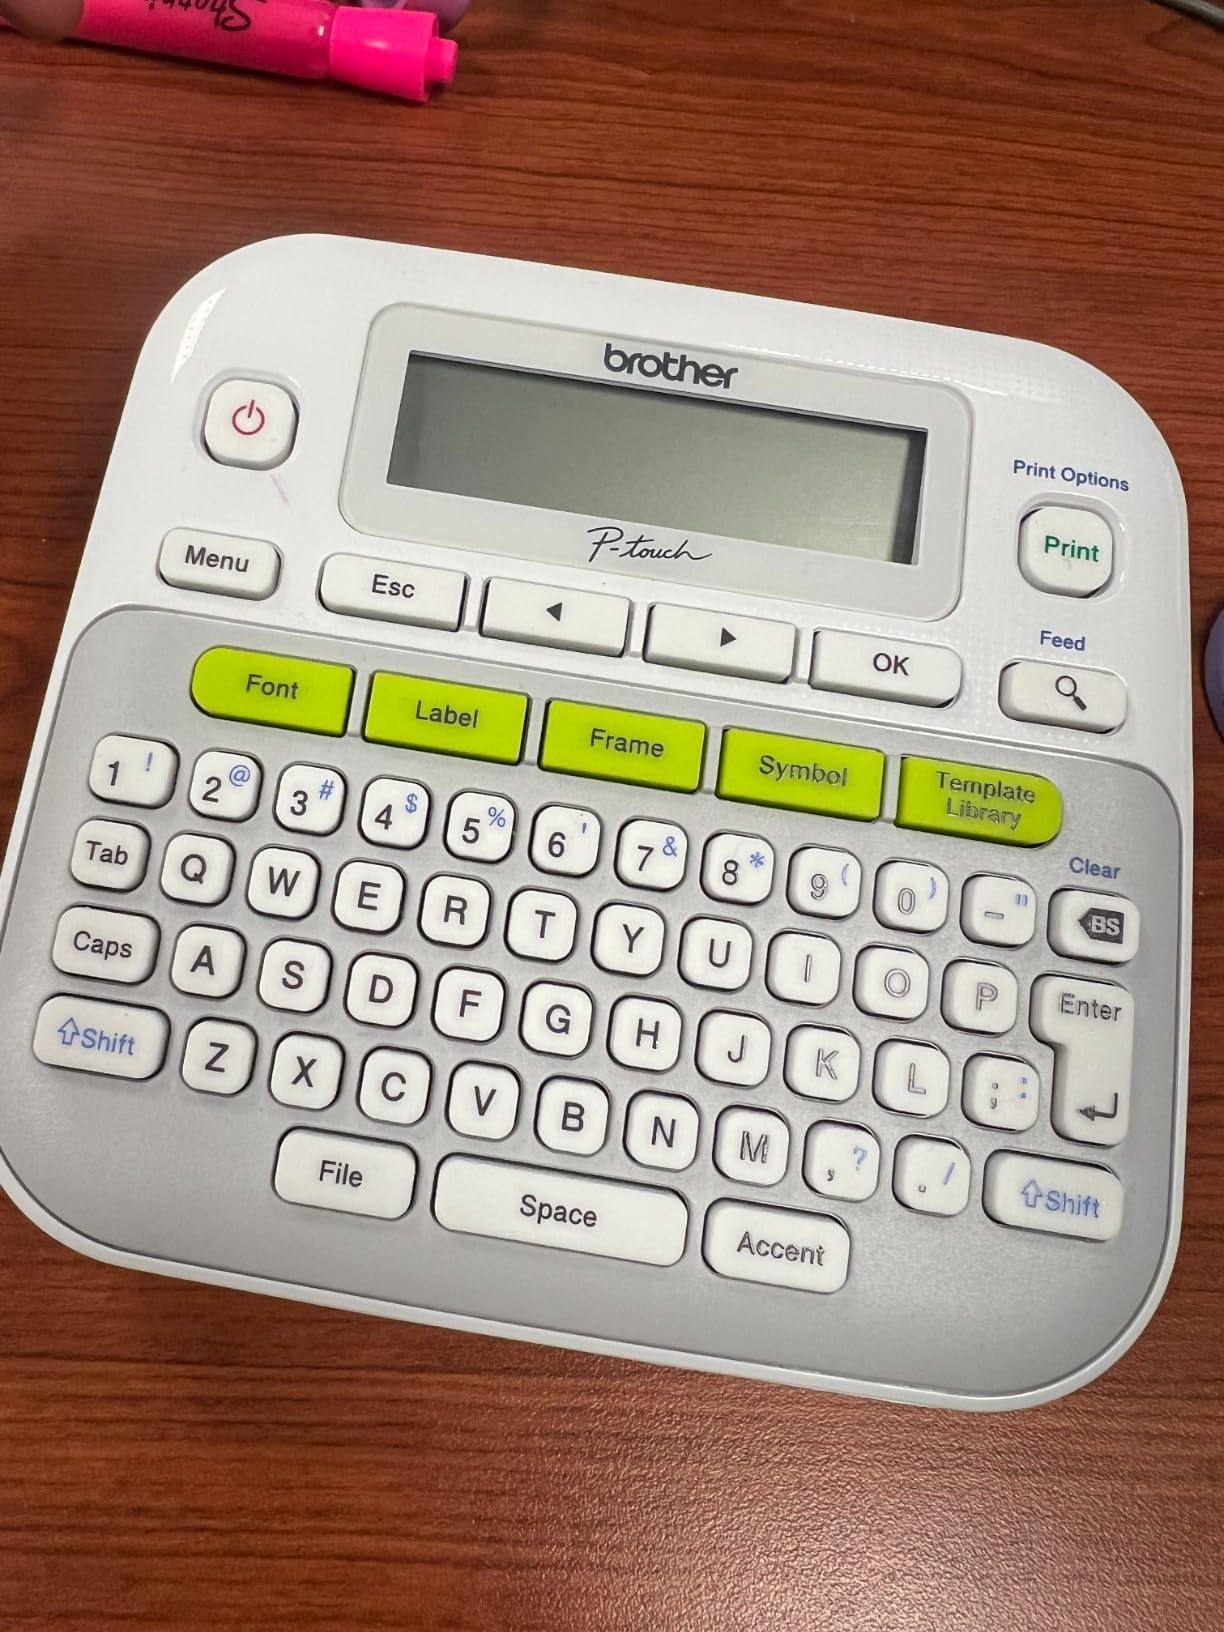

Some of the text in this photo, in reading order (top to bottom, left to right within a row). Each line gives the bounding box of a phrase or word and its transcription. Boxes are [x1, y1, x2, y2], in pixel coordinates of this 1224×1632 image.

[603, 343, 738, 389] brother
[1013, 459, 1130, 492] Print Options
[184, 545, 249, 573] Menu
[587, 526, 713, 562] P-touch
[1044, 535, 1100, 563] Print
[371, 574, 416, 599] Esc
[1040, 630, 1086, 652] Feed
[873, 652, 910, 676] OK
[245, 673, 299, 700] Font
[415, 700, 479, 728] Label
[590, 728, 665, 758] Frame
[108, 752, 153, 786] 1 !
[202, 765, 251, 802] 2 @
[759, 754, 848, 786] Symbol
[290, 779, 335, 816] 3 #
[936, 771, 1036, 804] Template
[374, 792, 418, 830] 4 $
[462, 806, 507, 844] 5 %
[946, 797, 1022, 831] Library
[86, 840, 129, 866] Tab
[547, 832, 566, 858] 6
[636, 836, 678, 871] 7 &
[180, 853, 207, 885] Q
[268, 866, 301, 897] W
[721, 859, 740, 886] 8
[810, 863, 849, 901] 9 (
[1069, 856, 1121, 880] Clear
[357, 881, 382, 910] E
[443, 895, 468, 925] R
[897, 877, 937, 915] 0 )
[534, 909, 556, 939] T
[622, 924, 645, 953] Y
[1091, 915, 1121, 936] BS
[73, 930, 133, 961] Caps
[190, 945, 215, 976] A
[708, 938, 732, 968] U
[281, 960, 305, 990] S
[804, 953, 813, 983] I
[884, 968, 911, 998] O
[369, 974, 394, 1004] D
[459, 988, 482, 1018] F
[975, 982, 998, 1011] P
[545, 1004, 571, 1035] G
[1060, 991, 1123, 1022] Enter
[80, 1022, 136, 1056] Shift
[635, 1017, 661, 1049] H
[204, 1041, 230, 1073] Z
[727, 1034, 746, 1064] J
[815, 1048, 839, 1080] K
[291, 1056, 318, 1088] X
[381, 1072, 407, 1101] C
[907, 1062, 927, 1094] L
[474, 1085, 497, 1117] V
[990, 1076, 1028, 1110] ; :
[561, 1101, 586, 1132] B
[651, 1116, 677, 1148] N
[739, 1130, 769, 1164] M
[853, 1147, 867, 1171] ?
[319, 1160, 363, 1188] File
[943, 1162, 955, 1186] /
[519, 1194, 598, 1228] Space
[1045, 1190, 1100, 1219] Shift
[736, 1231, 826, 1266] Accent
